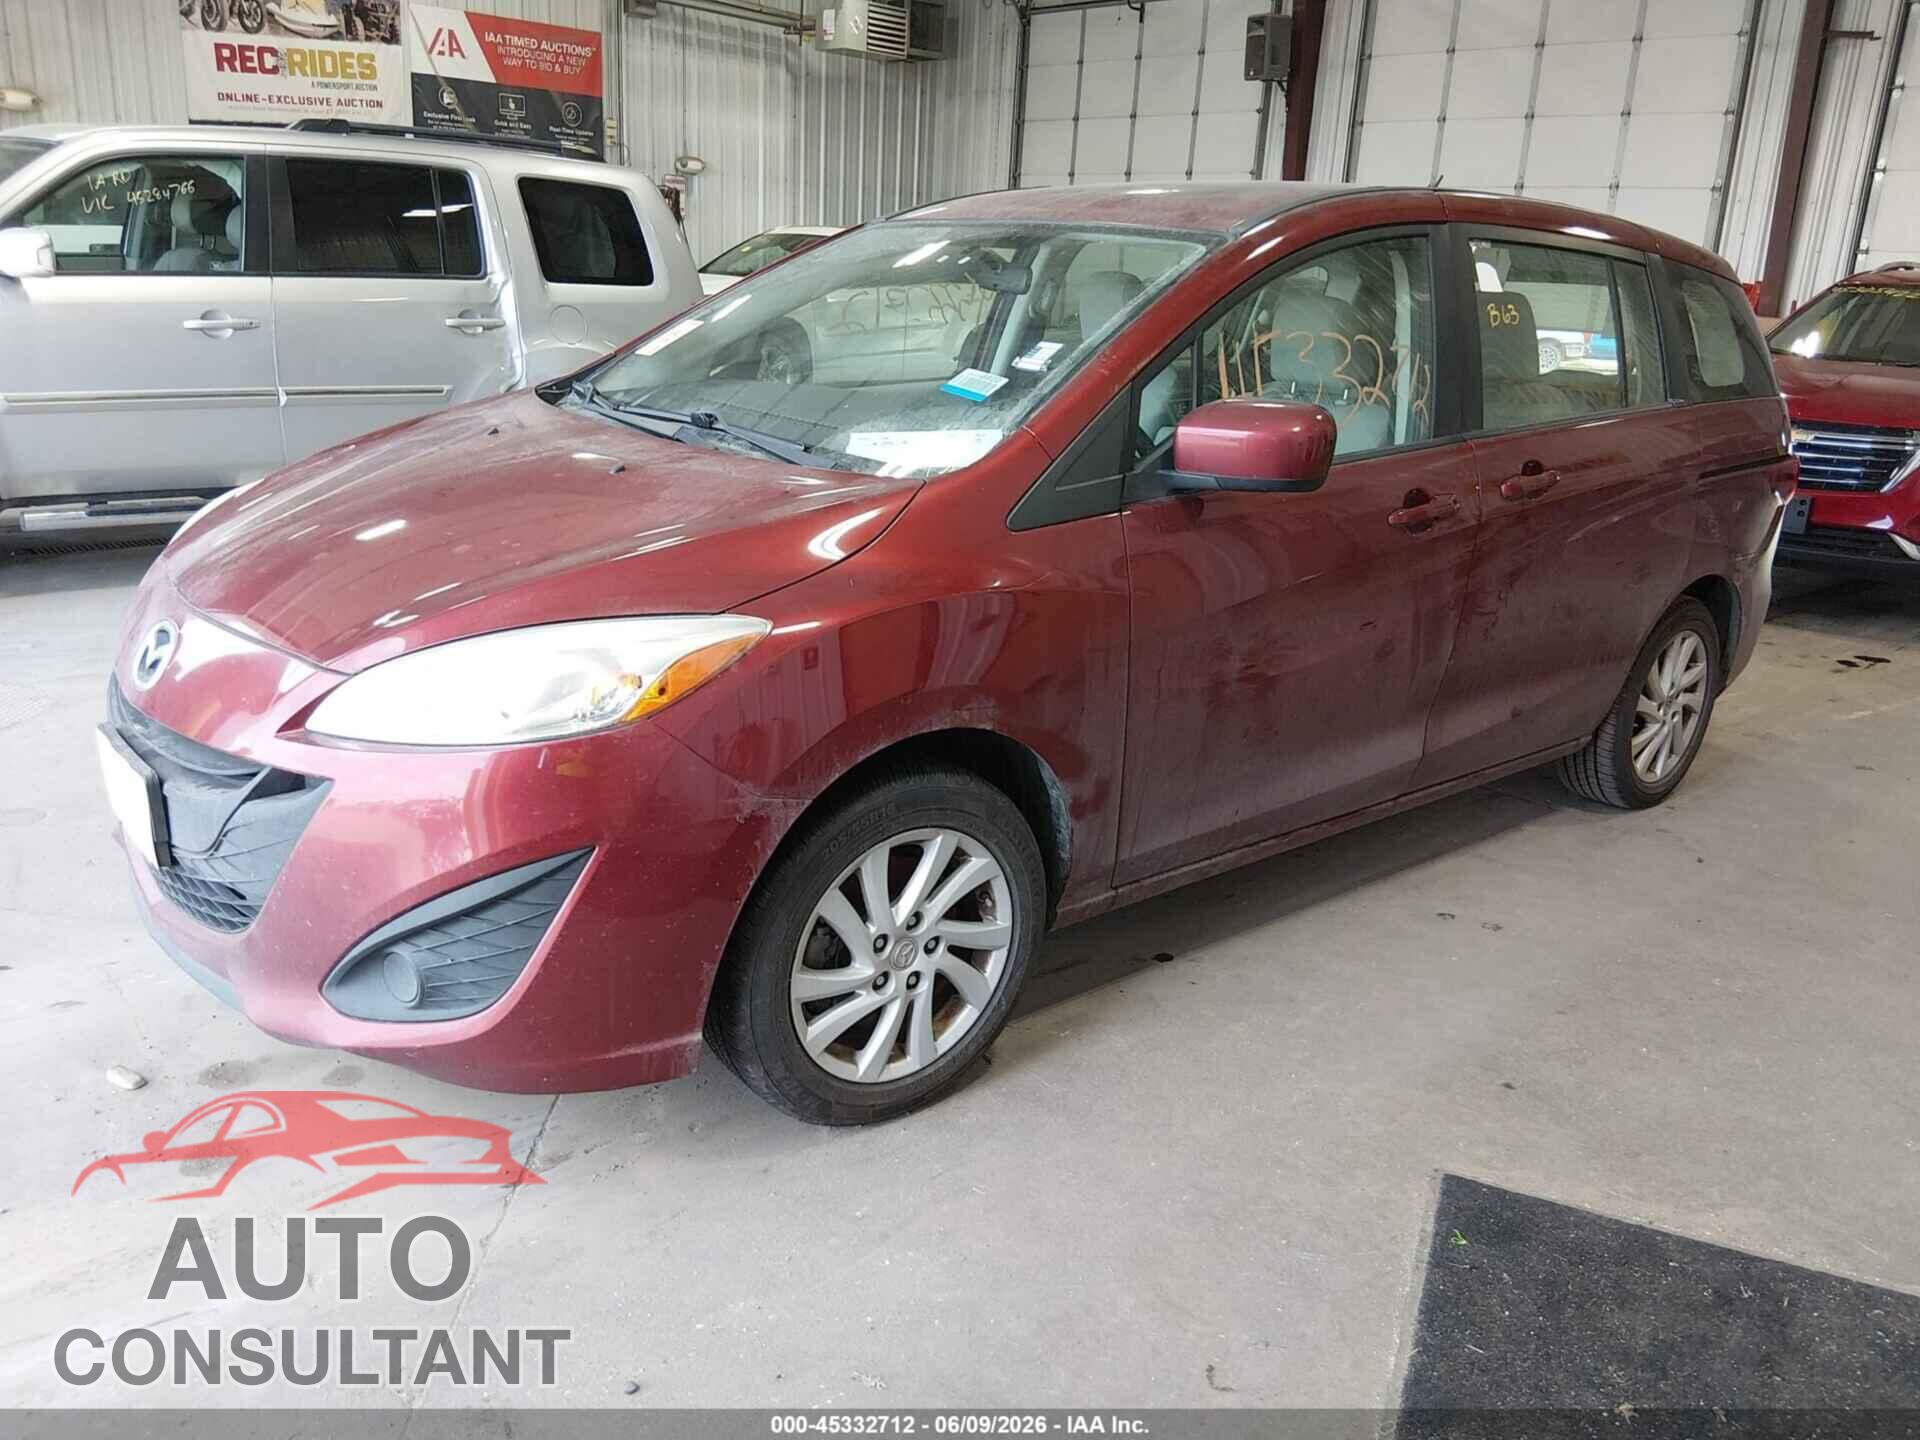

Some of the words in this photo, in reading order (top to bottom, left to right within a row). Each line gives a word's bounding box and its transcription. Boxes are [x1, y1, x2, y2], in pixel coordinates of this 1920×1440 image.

[485, 32, 504, 44] IAA
[505, 34, 537, 48] TIMED
[541, 39, 592, 57] AUCTIONS
[214, 42, 280, 76] REC
[286, 48, 378, 81] RIDES
[497, 45, 557, 63] INTRODUCING
[558, 53, 565, 63] A
[566, 55, 586, 67] NEW
[503, 56, 522, 67] WAY
[525, 59, 537, 69] TO
[554, 63, 562, 73] &
[564, 64, 583, 76] BUY
[353, 83, 378, 92] AUCTION
[217, 92, 333, 107] ONLINE-EXCLUSIVE
[336, 98, 383, 109] AUCTION
